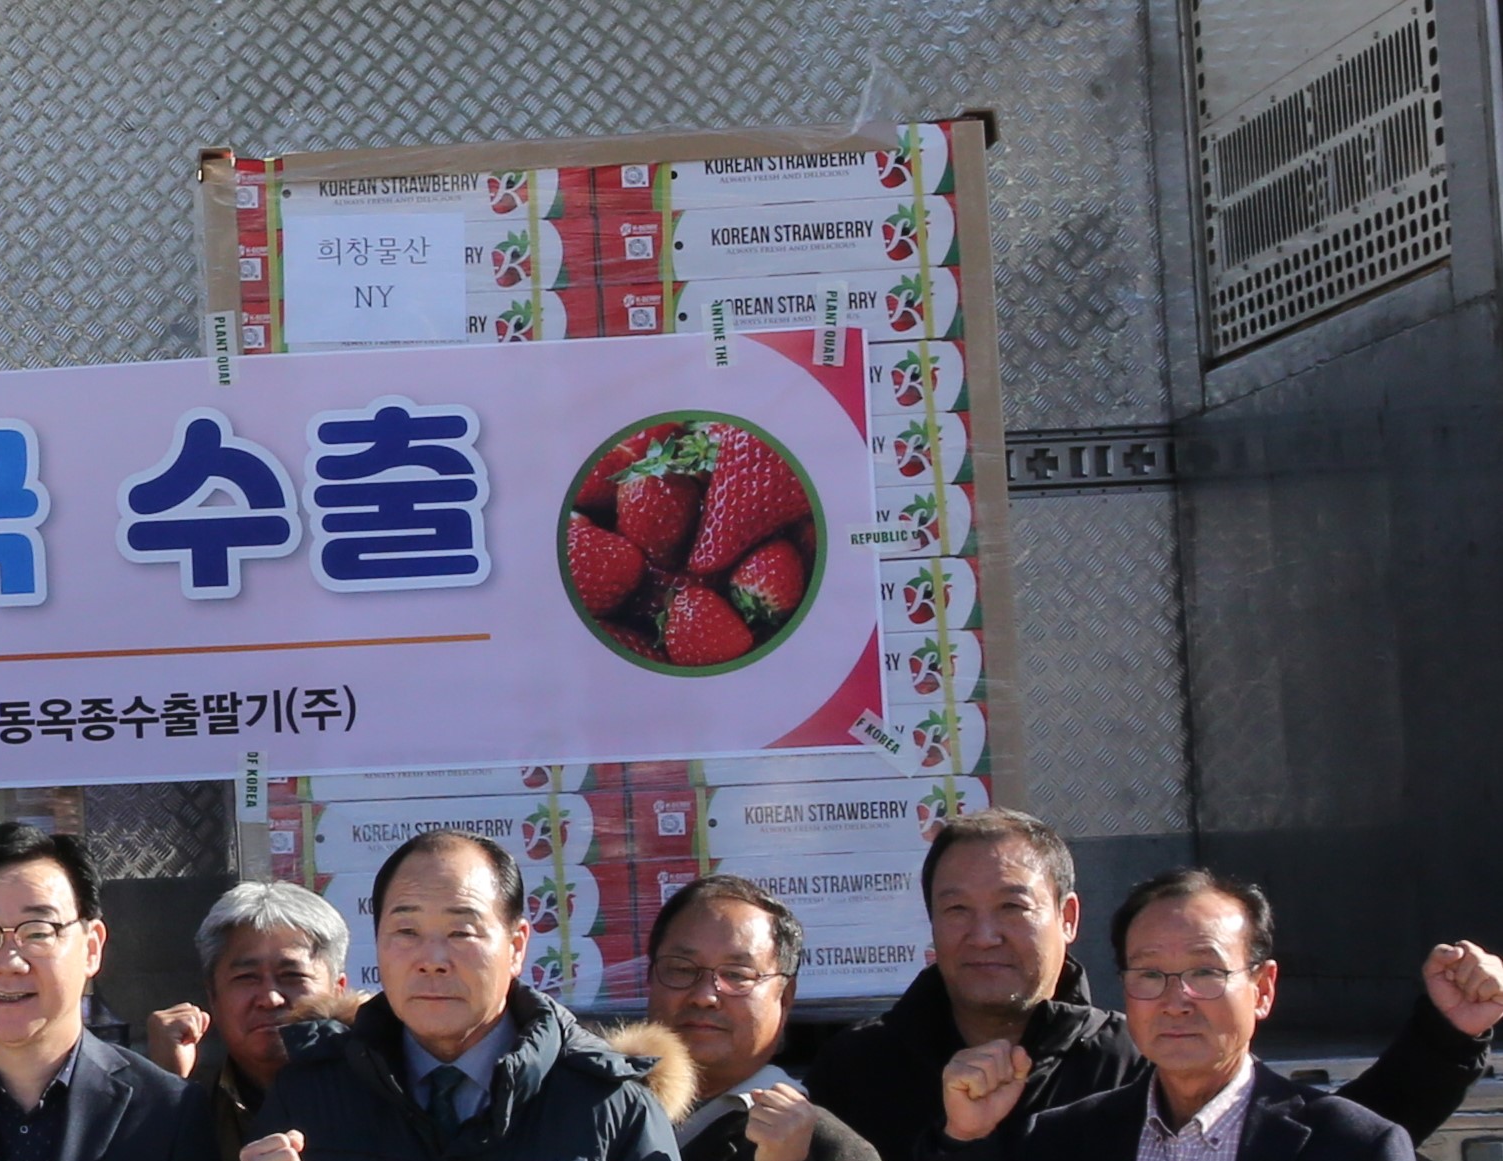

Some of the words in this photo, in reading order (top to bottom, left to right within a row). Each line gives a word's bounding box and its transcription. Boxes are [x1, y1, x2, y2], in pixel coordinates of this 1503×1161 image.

[704, 157, 764, 175] KOREAN
[767, 152, 867, 172] STRAWBERRY
[318, 178, 377, 197] KOREAN
[380, 173, 479, 194] STRAWBERRY
[711, 227, 770, 246] KOREAN
[773, 220, 874, 243] STRAWBERRY
[316, 235, 433, 267] 희창물산
[353, 285, 395, 309] NY
[776, 291, 878, 314] STRARRY
[824, 290, 838, 326] PLANT
[213, 316, 228, 352] PLANT
[715, 345, 729, 367] THE
[822, 330, 837, 367] QUAR
[123, 403, 482, 591] 수출
[850, 529, 909, 546] REPUBLIC
[864, 722, 902, 756] KOREA
[245, 769, 259, 809] KOREA
[744, 804, 804, 825] KOREAN
[808, 800, 908, 822] STRAWBERRY
[817, 944, 916, 966] STRAWBERRY
